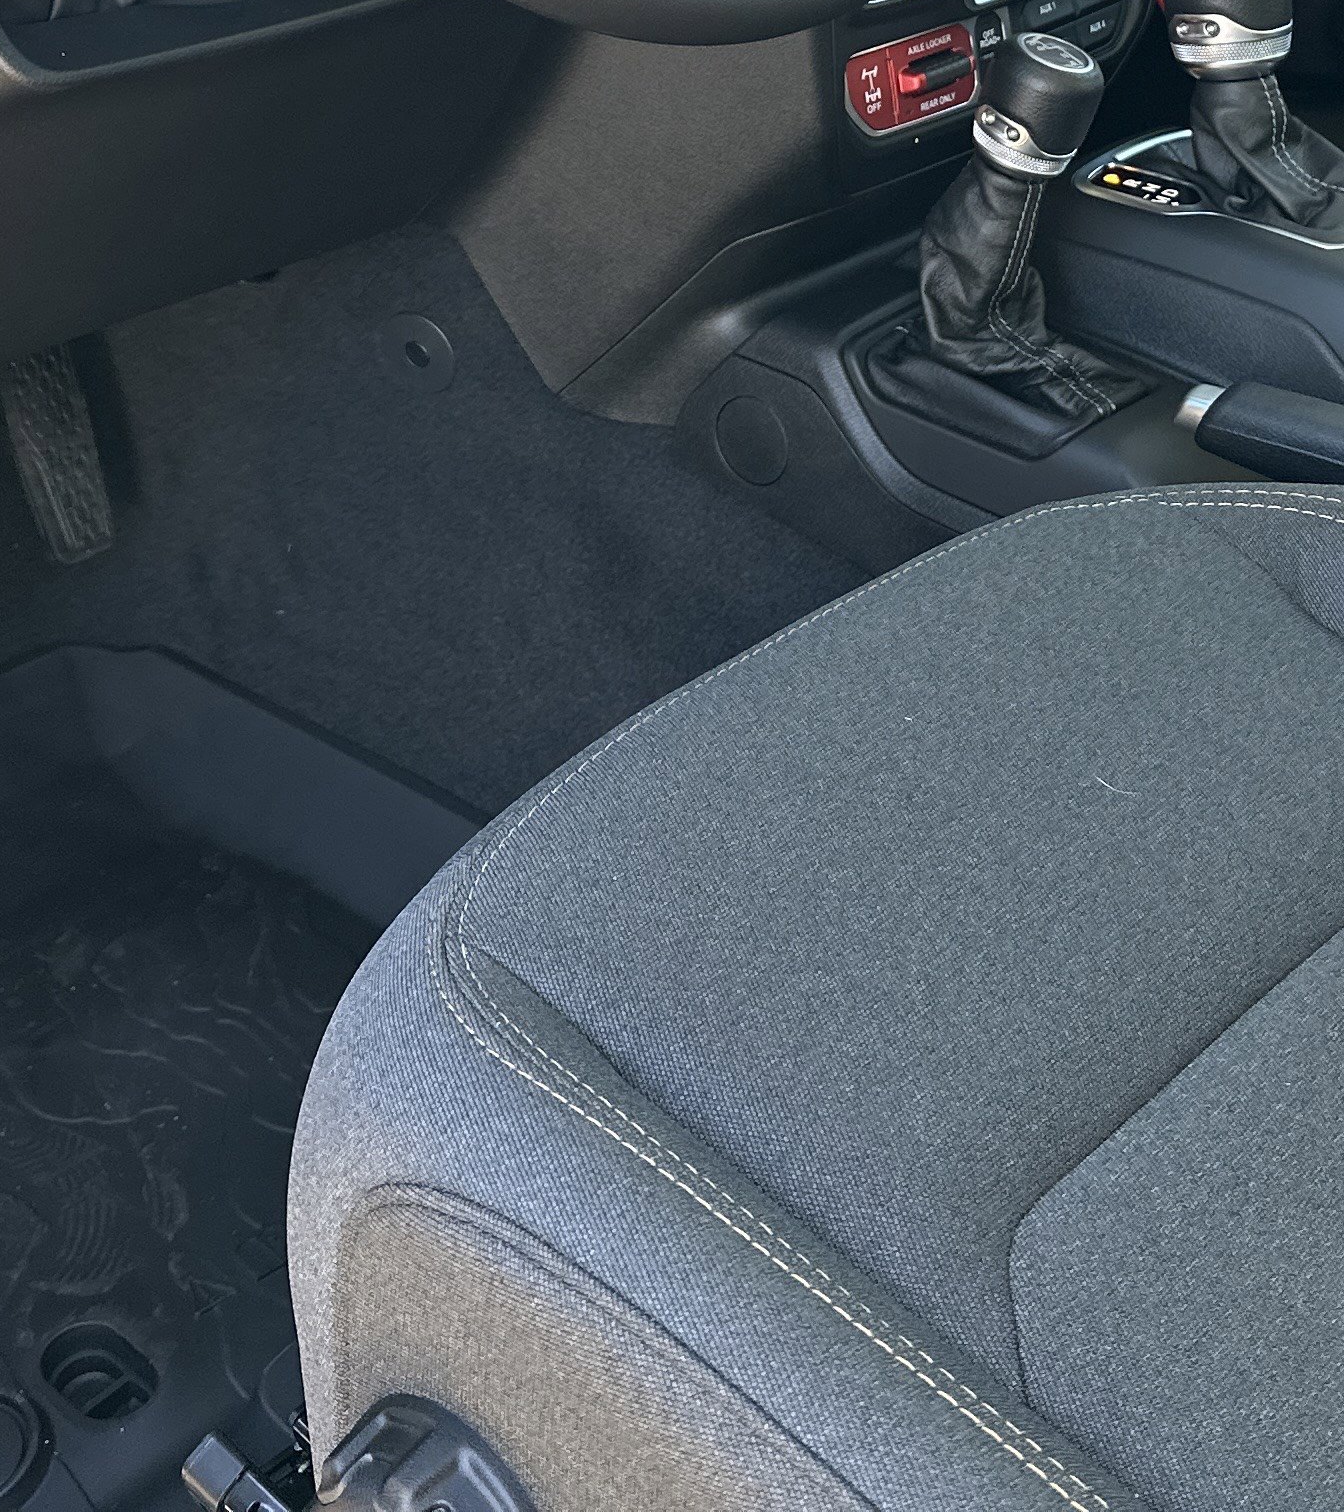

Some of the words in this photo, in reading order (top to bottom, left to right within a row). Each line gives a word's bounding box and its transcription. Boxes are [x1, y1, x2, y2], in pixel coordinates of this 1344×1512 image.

[908, 42, 925, 55] AXLE
[925, 34, 952, 49] LOCKER
[867, 101, 882, 114] OFF
[920, 98, 939, 111] REAR
[939, 92, 956, 105] ONLY
